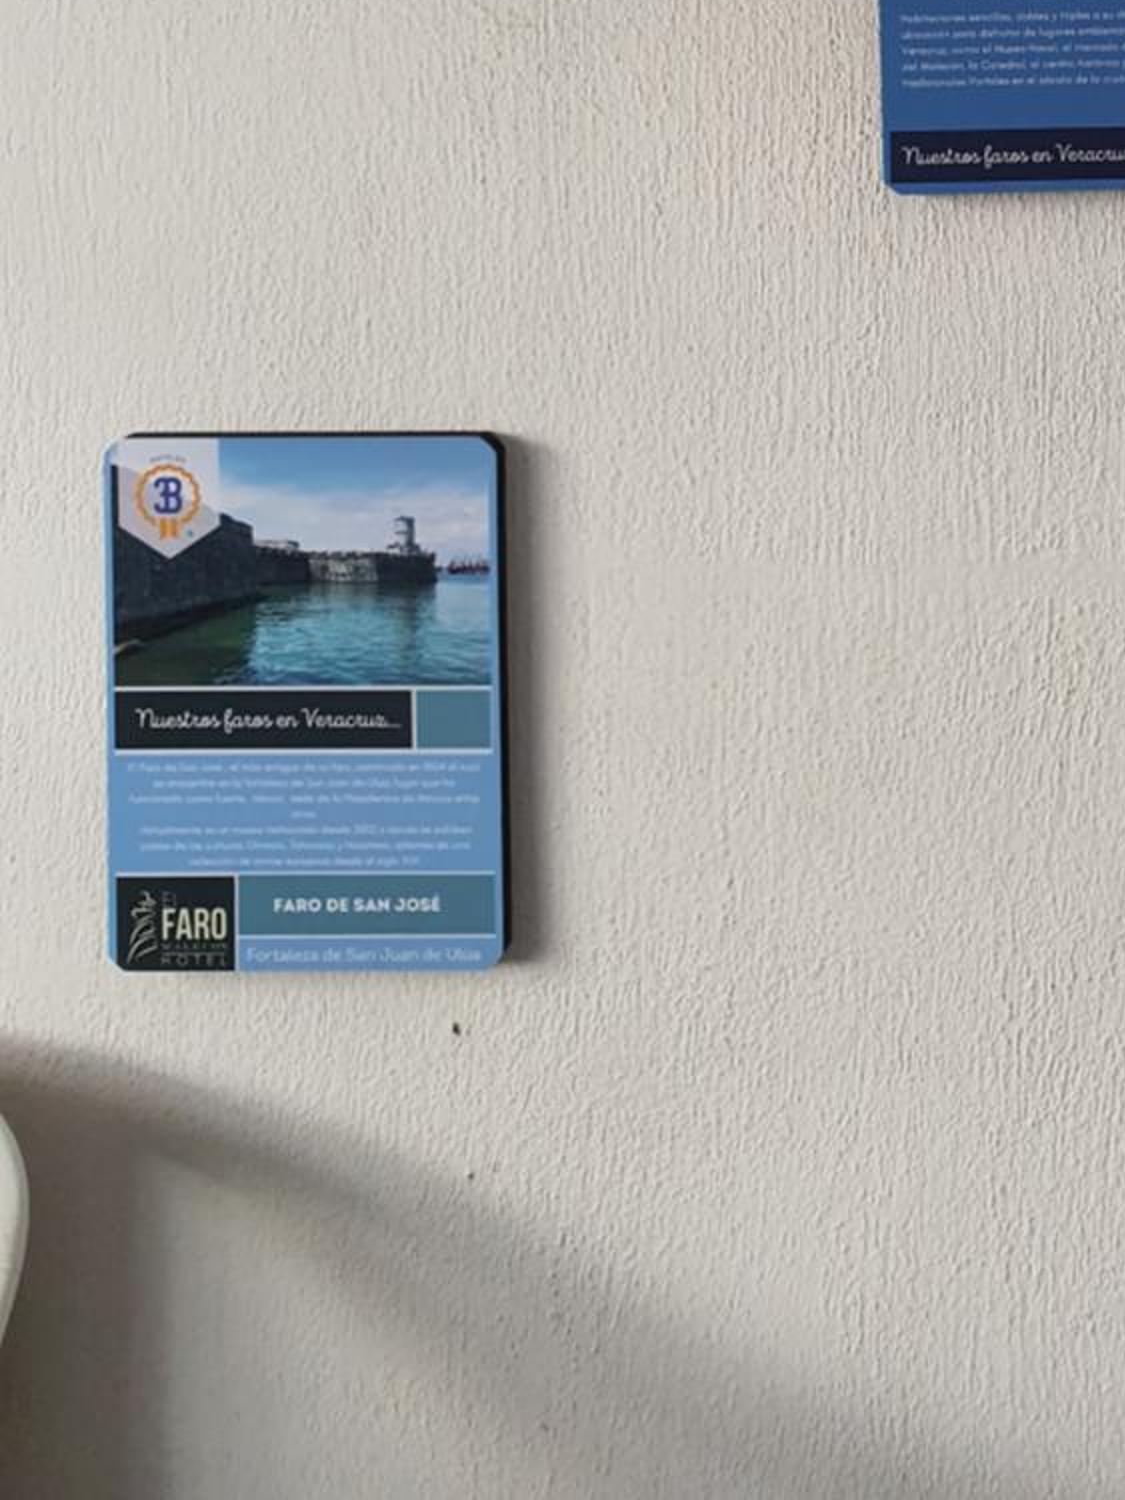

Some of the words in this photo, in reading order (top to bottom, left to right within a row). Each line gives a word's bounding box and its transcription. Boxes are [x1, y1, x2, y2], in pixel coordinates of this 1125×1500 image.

[901, 145, 981, 166] Nuestros
[982, 144, 1030, 169] faros
[1031, 149, 1053, 163] en
[134, 708, 221, 729] Nuestros
[222, 707, 274, 734] faros
[276, 713, 299, 728] en
[273, 896, 321, 913] FARO
[326, 897, 348, 913] DE
[353, 897, 390, 913] SAN
[393, 892, 441, 913] JOSÉ
[161, 907, 227, 940] FARO
[322, 947, 341, 962] de
